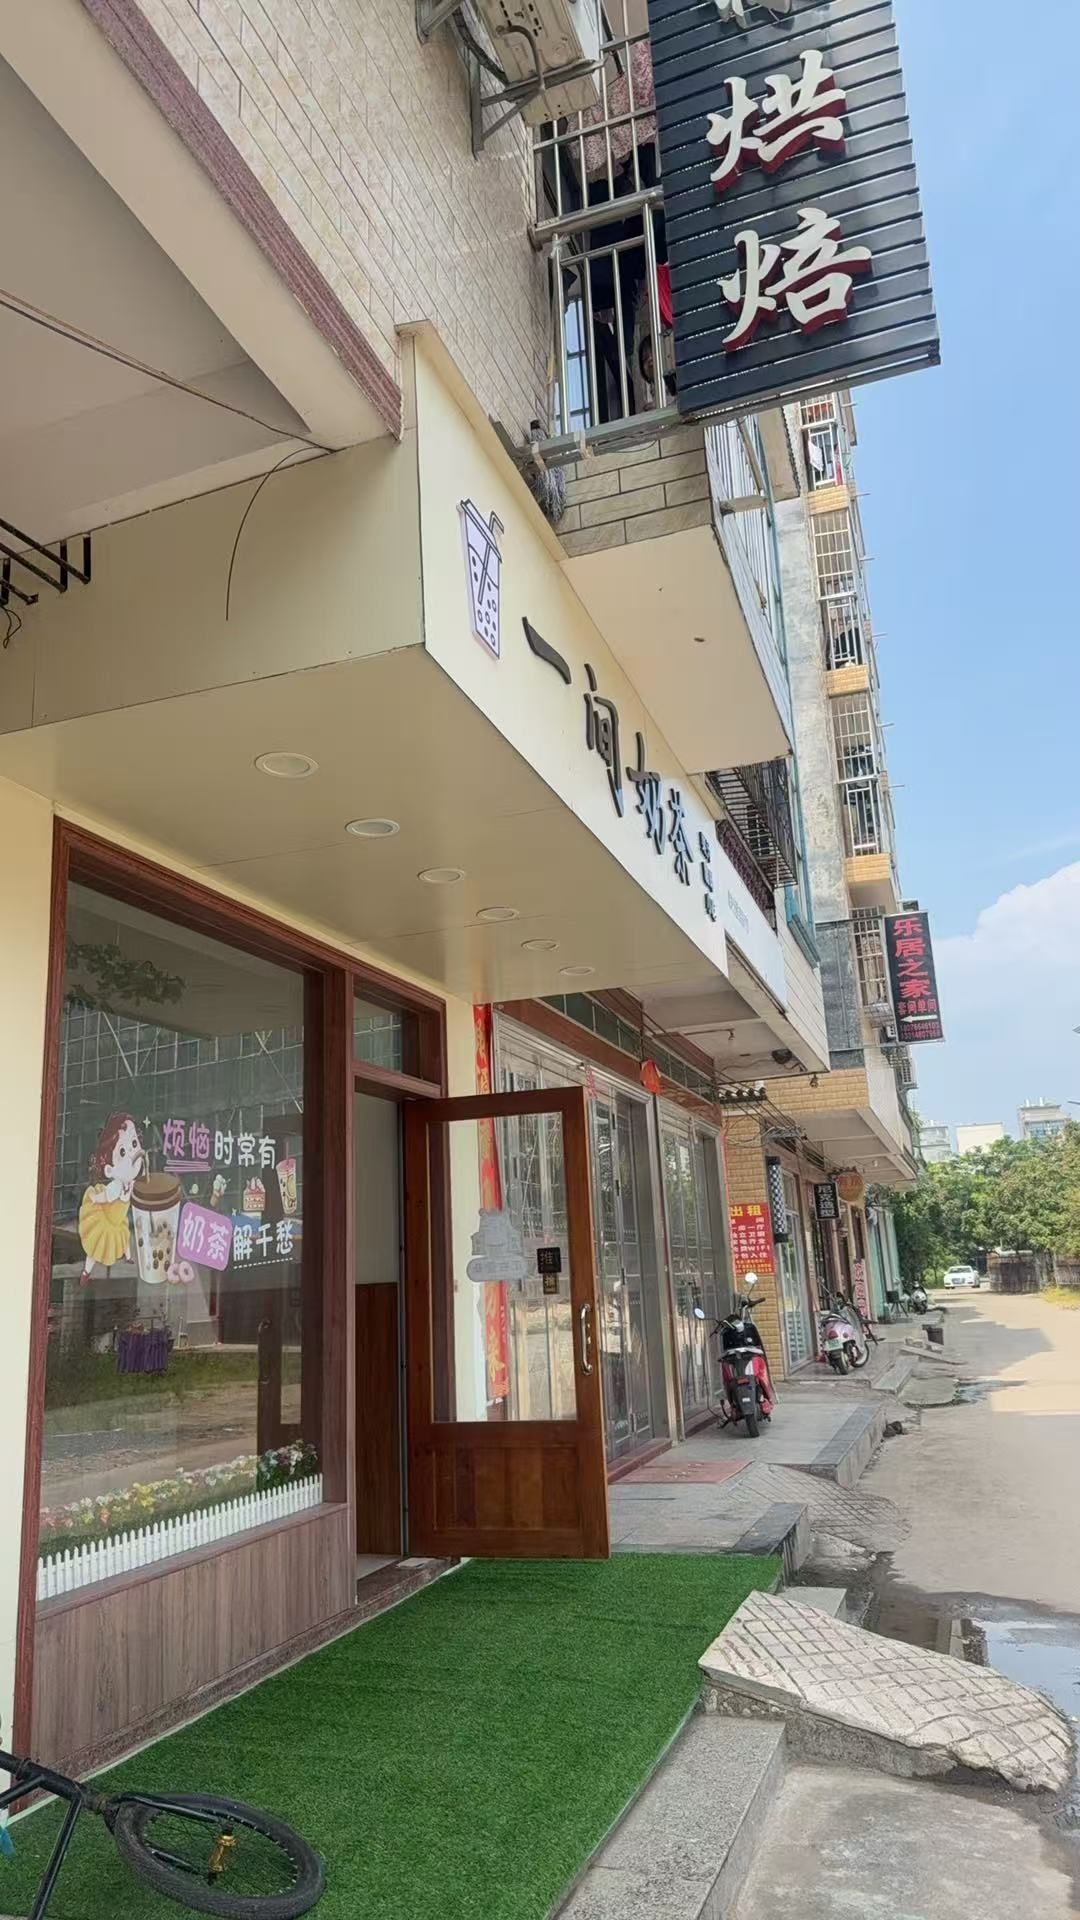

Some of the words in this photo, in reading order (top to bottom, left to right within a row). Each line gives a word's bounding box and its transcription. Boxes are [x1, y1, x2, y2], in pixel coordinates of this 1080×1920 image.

[706, 0, 872, 347] 烘焙
[522, 615, 693, 886] 一间奶茶
[893, 916, 932, 999] 乐居之家
[163, 1118, 276, 1170] 烦恼时常有
[182, 1212, 294, 1262] 奶茶解千愁
[730, 1204, 762, 1216] 出租
